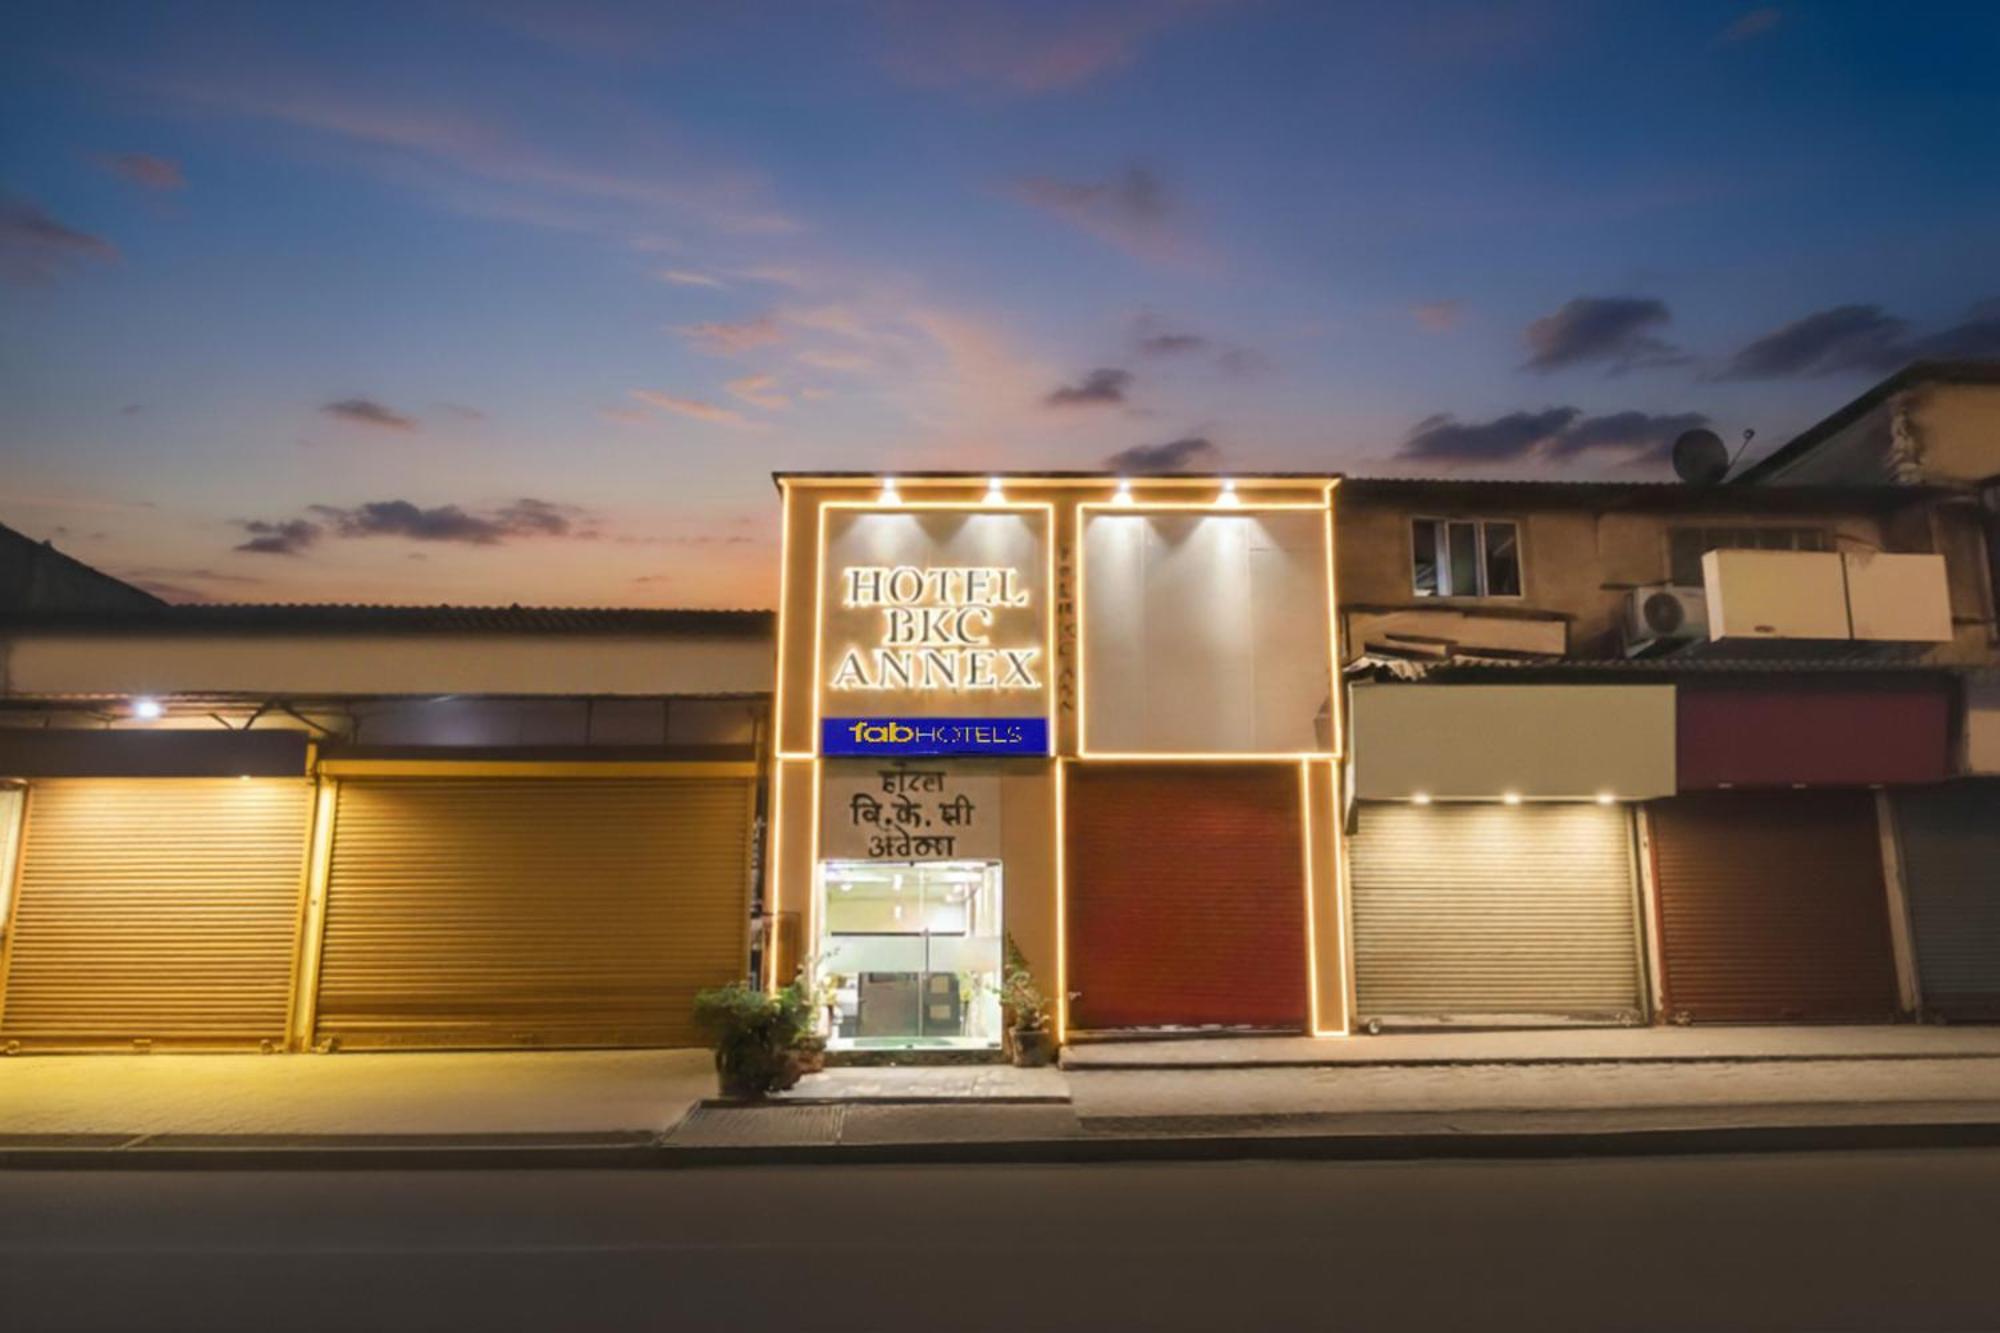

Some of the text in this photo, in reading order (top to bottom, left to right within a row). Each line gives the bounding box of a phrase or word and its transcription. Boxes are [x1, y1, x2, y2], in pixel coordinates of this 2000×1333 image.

[845, 568, 1028, 605] HOTEL
[883, 608, 990, 645] BKC
[831, 650, 1040, 688] ANNEX
[849, 722, 1022, 743] fabHOTELS
